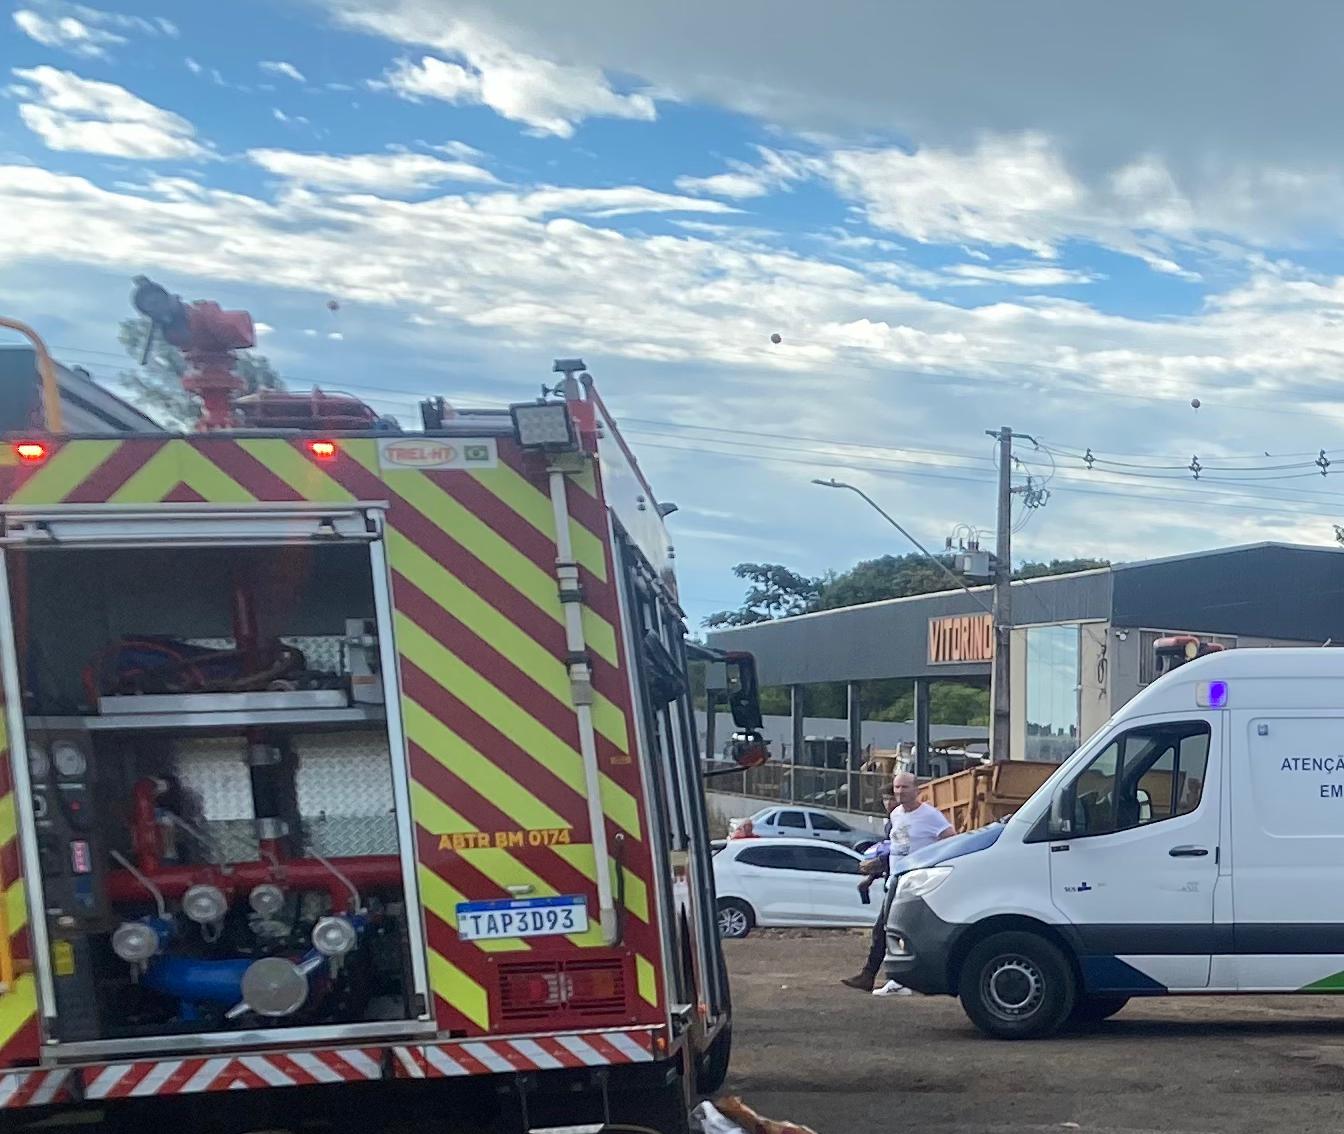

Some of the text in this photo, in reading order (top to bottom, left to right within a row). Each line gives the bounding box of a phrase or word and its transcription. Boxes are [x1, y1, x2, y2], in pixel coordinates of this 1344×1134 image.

[929, 614, 993, 662] VITORINO
[1320, 785, 1343, 798] EM
[438, 829, 570, 851] ABTR BM 0174
[470, 909, 574, 936] TAP3D93
